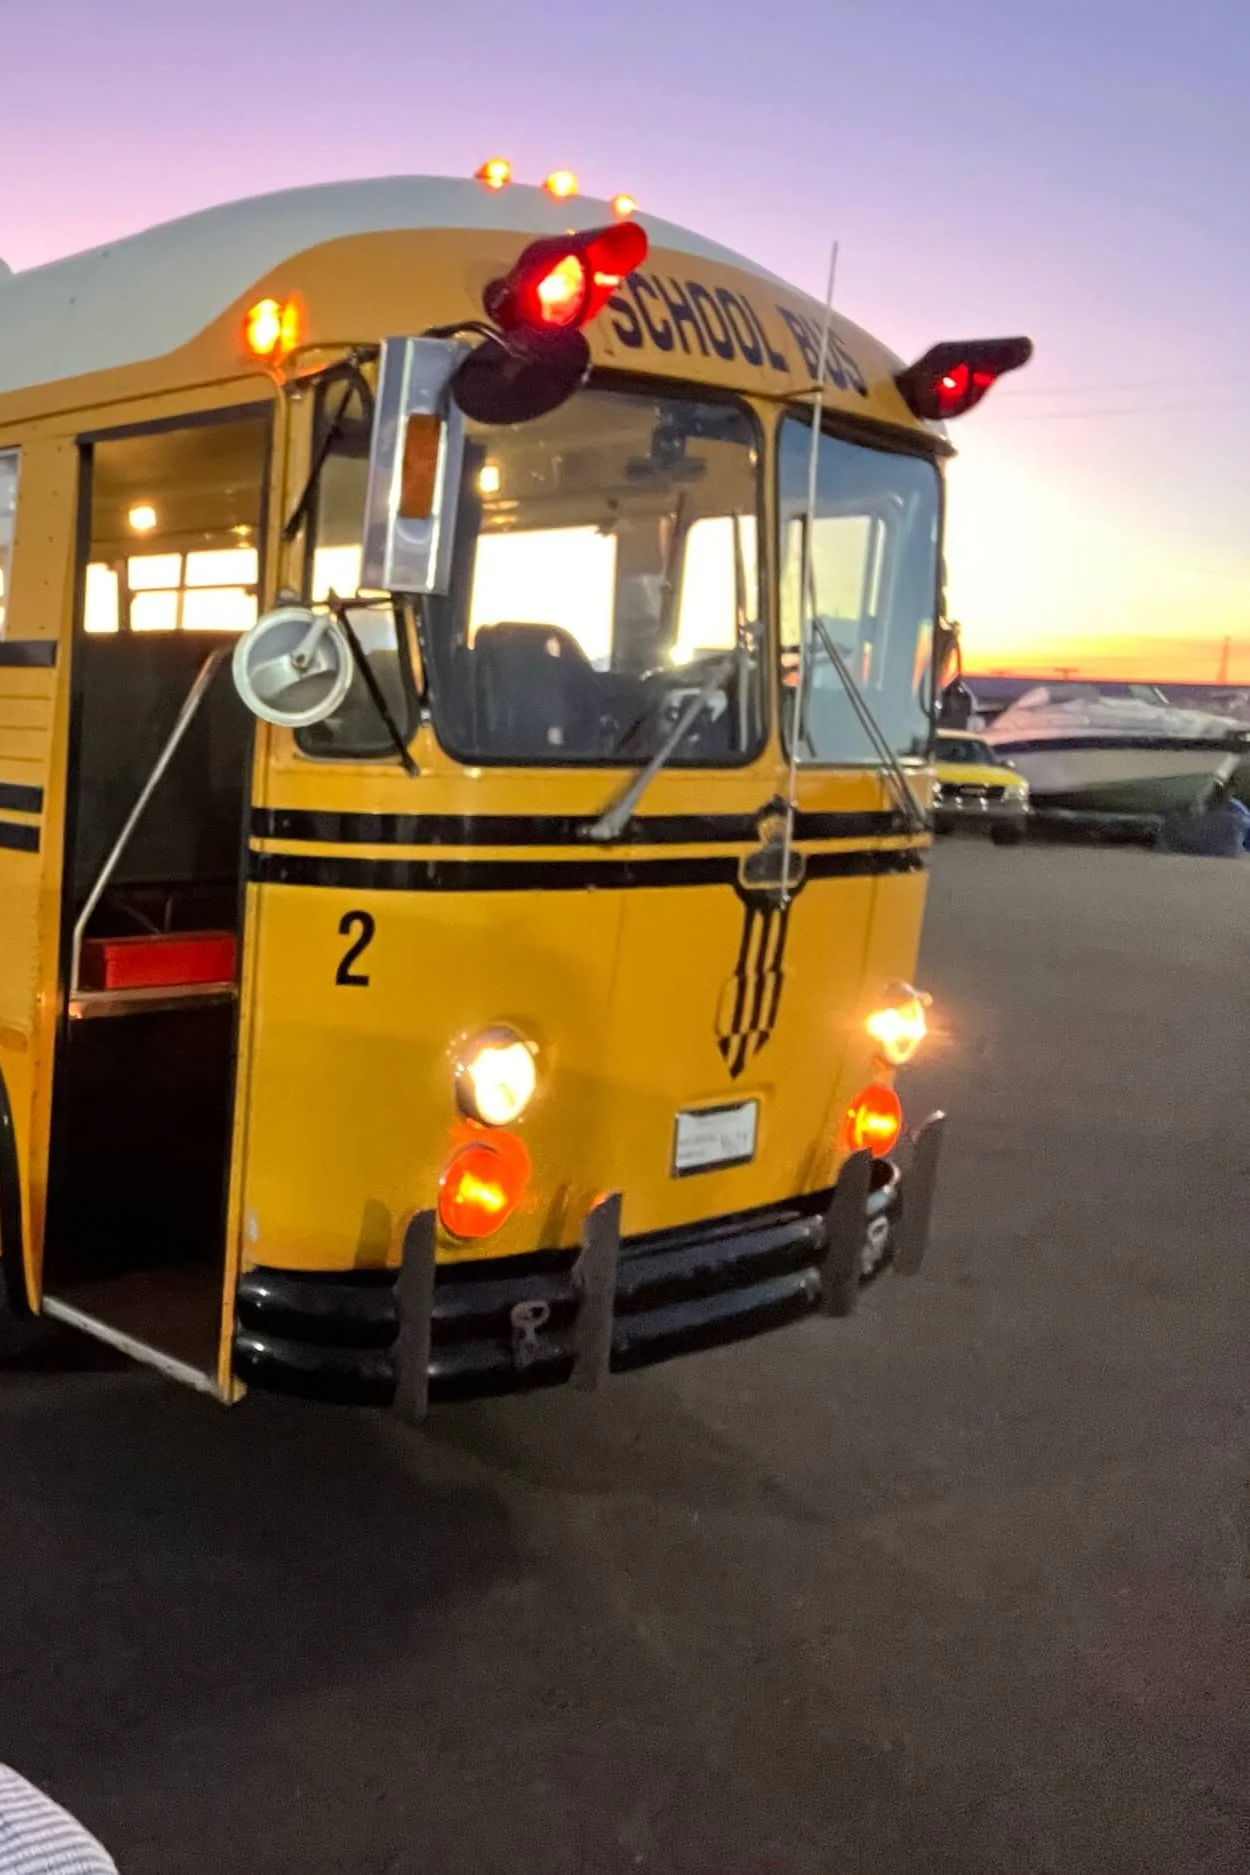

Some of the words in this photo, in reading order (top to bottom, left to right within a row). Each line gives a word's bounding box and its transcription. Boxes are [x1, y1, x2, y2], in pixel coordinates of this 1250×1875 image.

[607, 272, 790, 372] SCHOOL
[776, 304, 869, 398] BUS
[335, 909, 376, 987] 2
